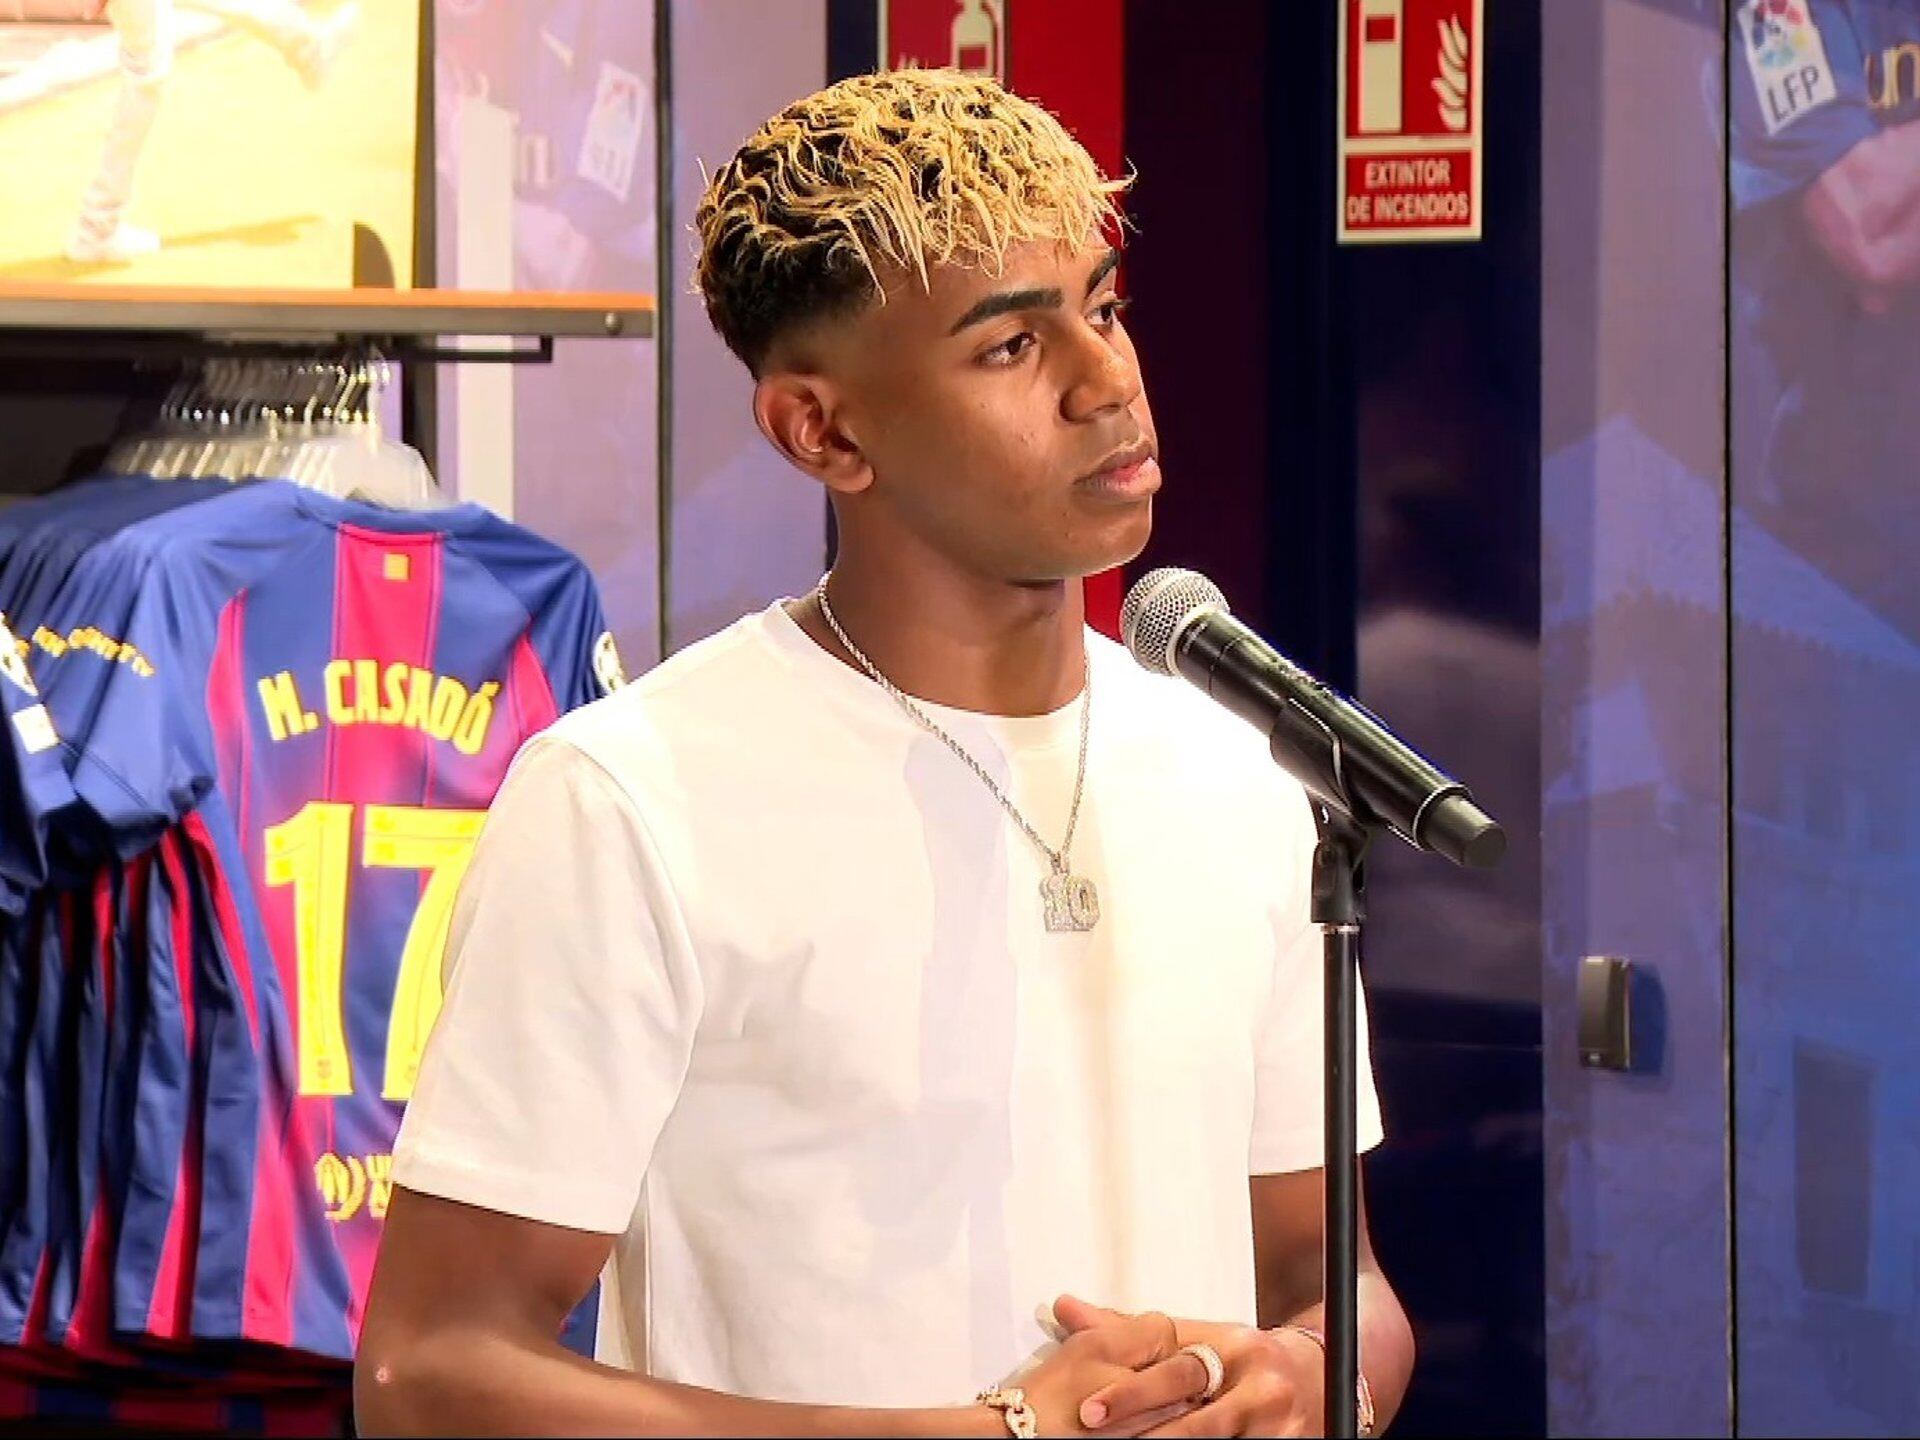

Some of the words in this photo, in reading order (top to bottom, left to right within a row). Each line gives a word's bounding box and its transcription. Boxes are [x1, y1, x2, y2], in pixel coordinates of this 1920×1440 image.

[1767, 66, 1819, 121] LFP
[1365, 159, 1451, 188] EXTINTOR
[1347, 196, 1371, 222] DE
[1374, 191, 1469, 221] INCENDIOS
[257, 670, 320, 741] M.
[324, 659, 501, 755] CASADÓ
[264, 803, 488, 1101] 17
